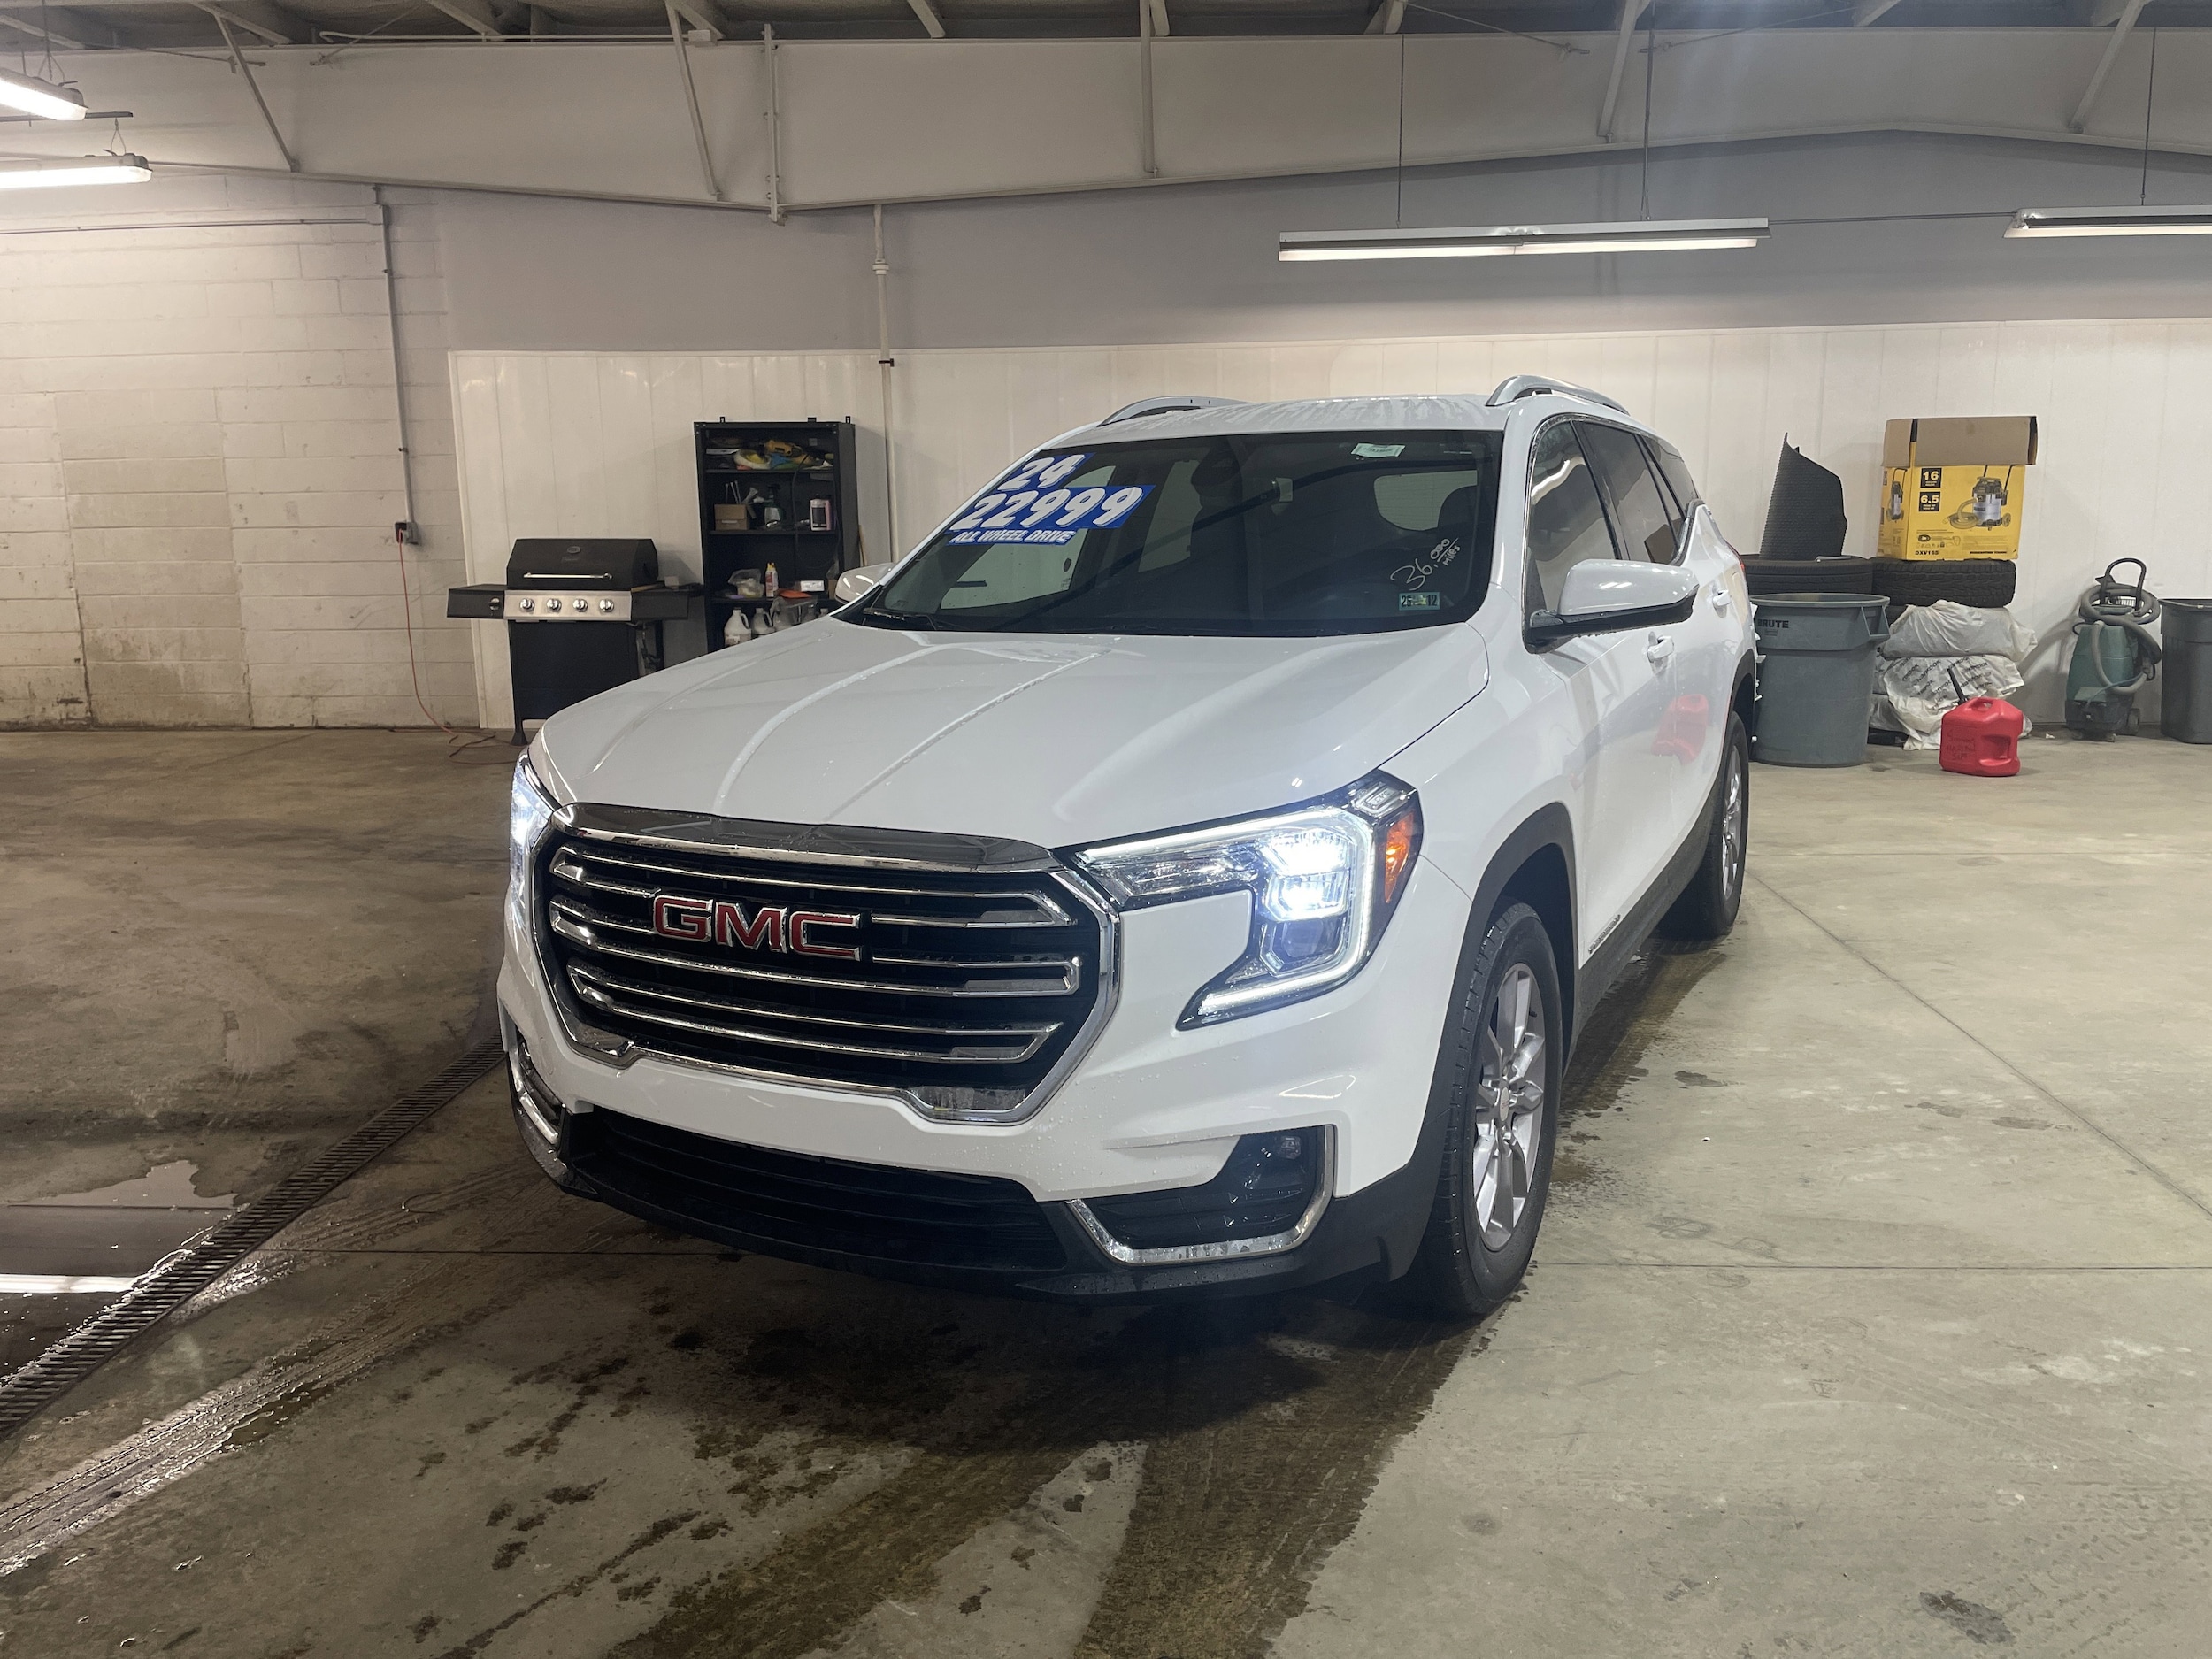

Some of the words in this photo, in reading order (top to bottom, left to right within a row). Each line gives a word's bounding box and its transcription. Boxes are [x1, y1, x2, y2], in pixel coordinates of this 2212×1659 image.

[997, 454, 1086, 492] 24
[1923, 471, 1939, 480] 16
[1920, 495, 1939, 504] 6.5
[949, 486, 1144, 531] 22999
[949, 530, 982, 543] ALL
[977, 529, 1029, 542] WHEEL
[1023, 530, 1077, 543] DRIVE
[1426, 595, 1437, 606] 12
[653, 895, 861, 962] GMC
